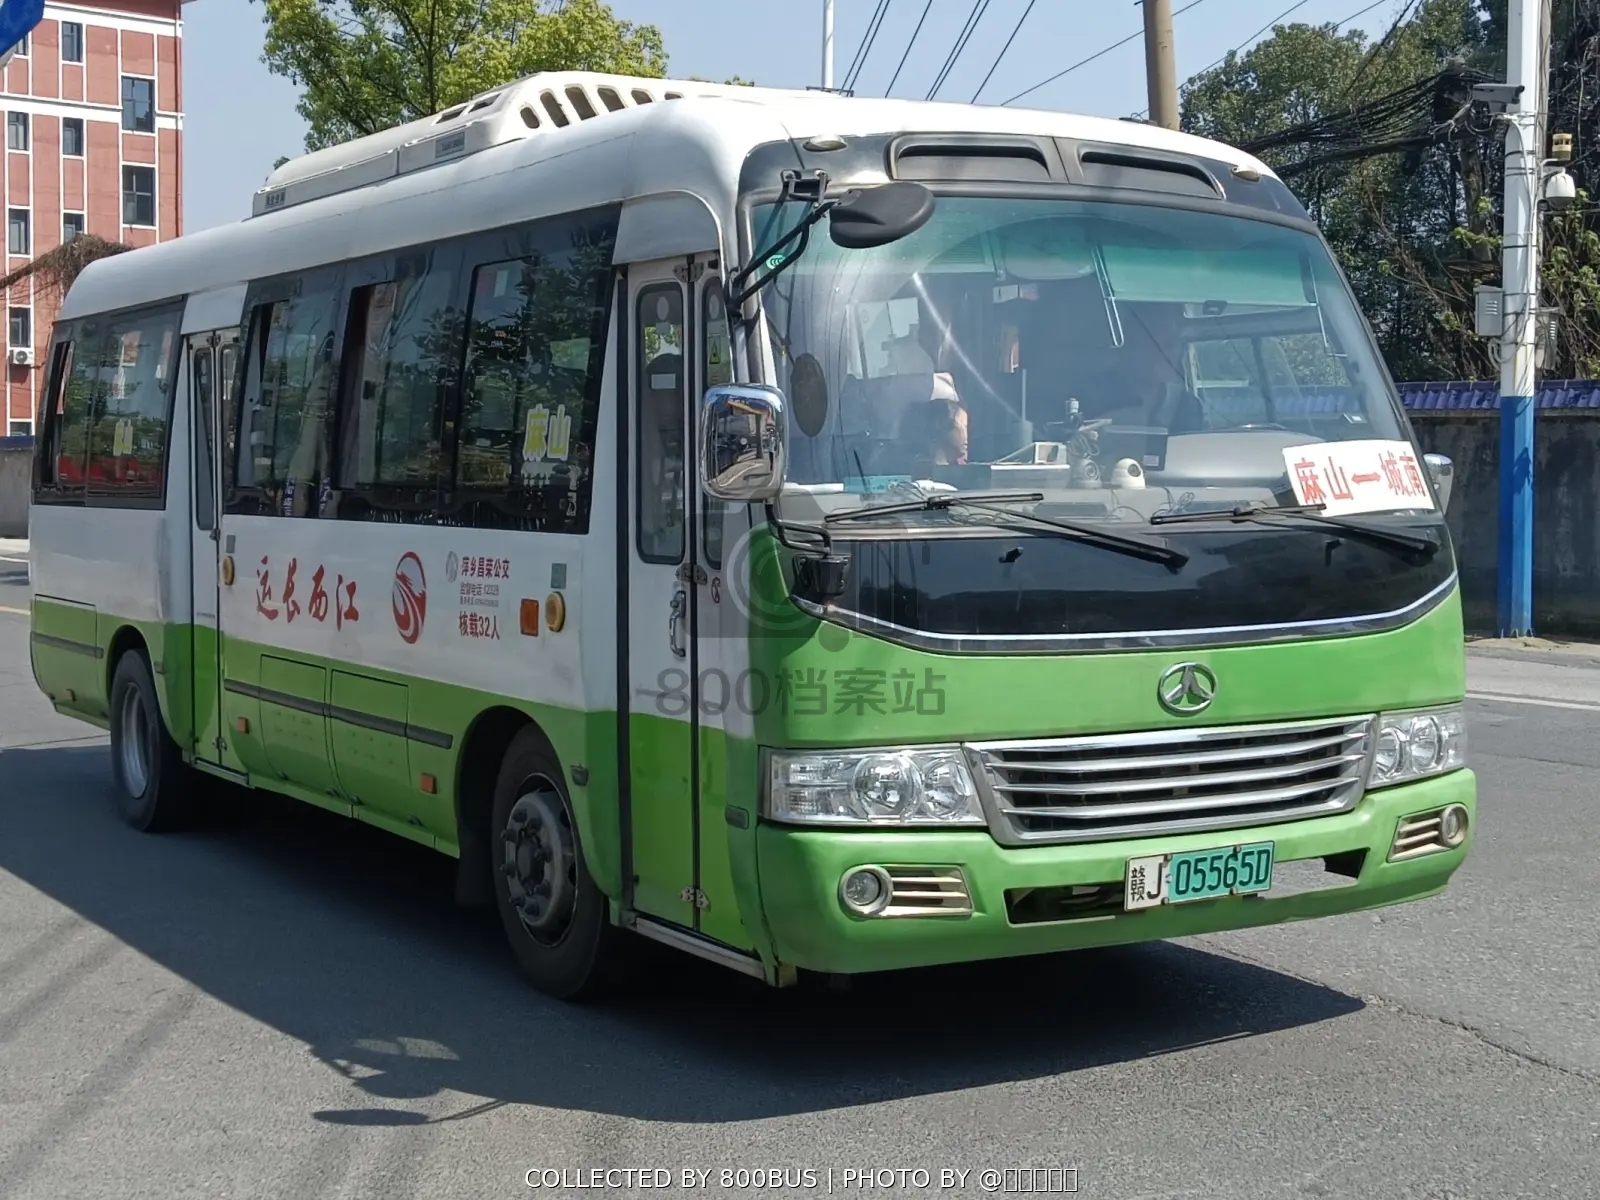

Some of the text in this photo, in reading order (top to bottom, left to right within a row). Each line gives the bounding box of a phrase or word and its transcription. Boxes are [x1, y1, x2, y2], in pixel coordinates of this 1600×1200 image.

[1294, 450, 1426, 505] 麻山 城南
[459, 611, 500, 640] 核载32人
